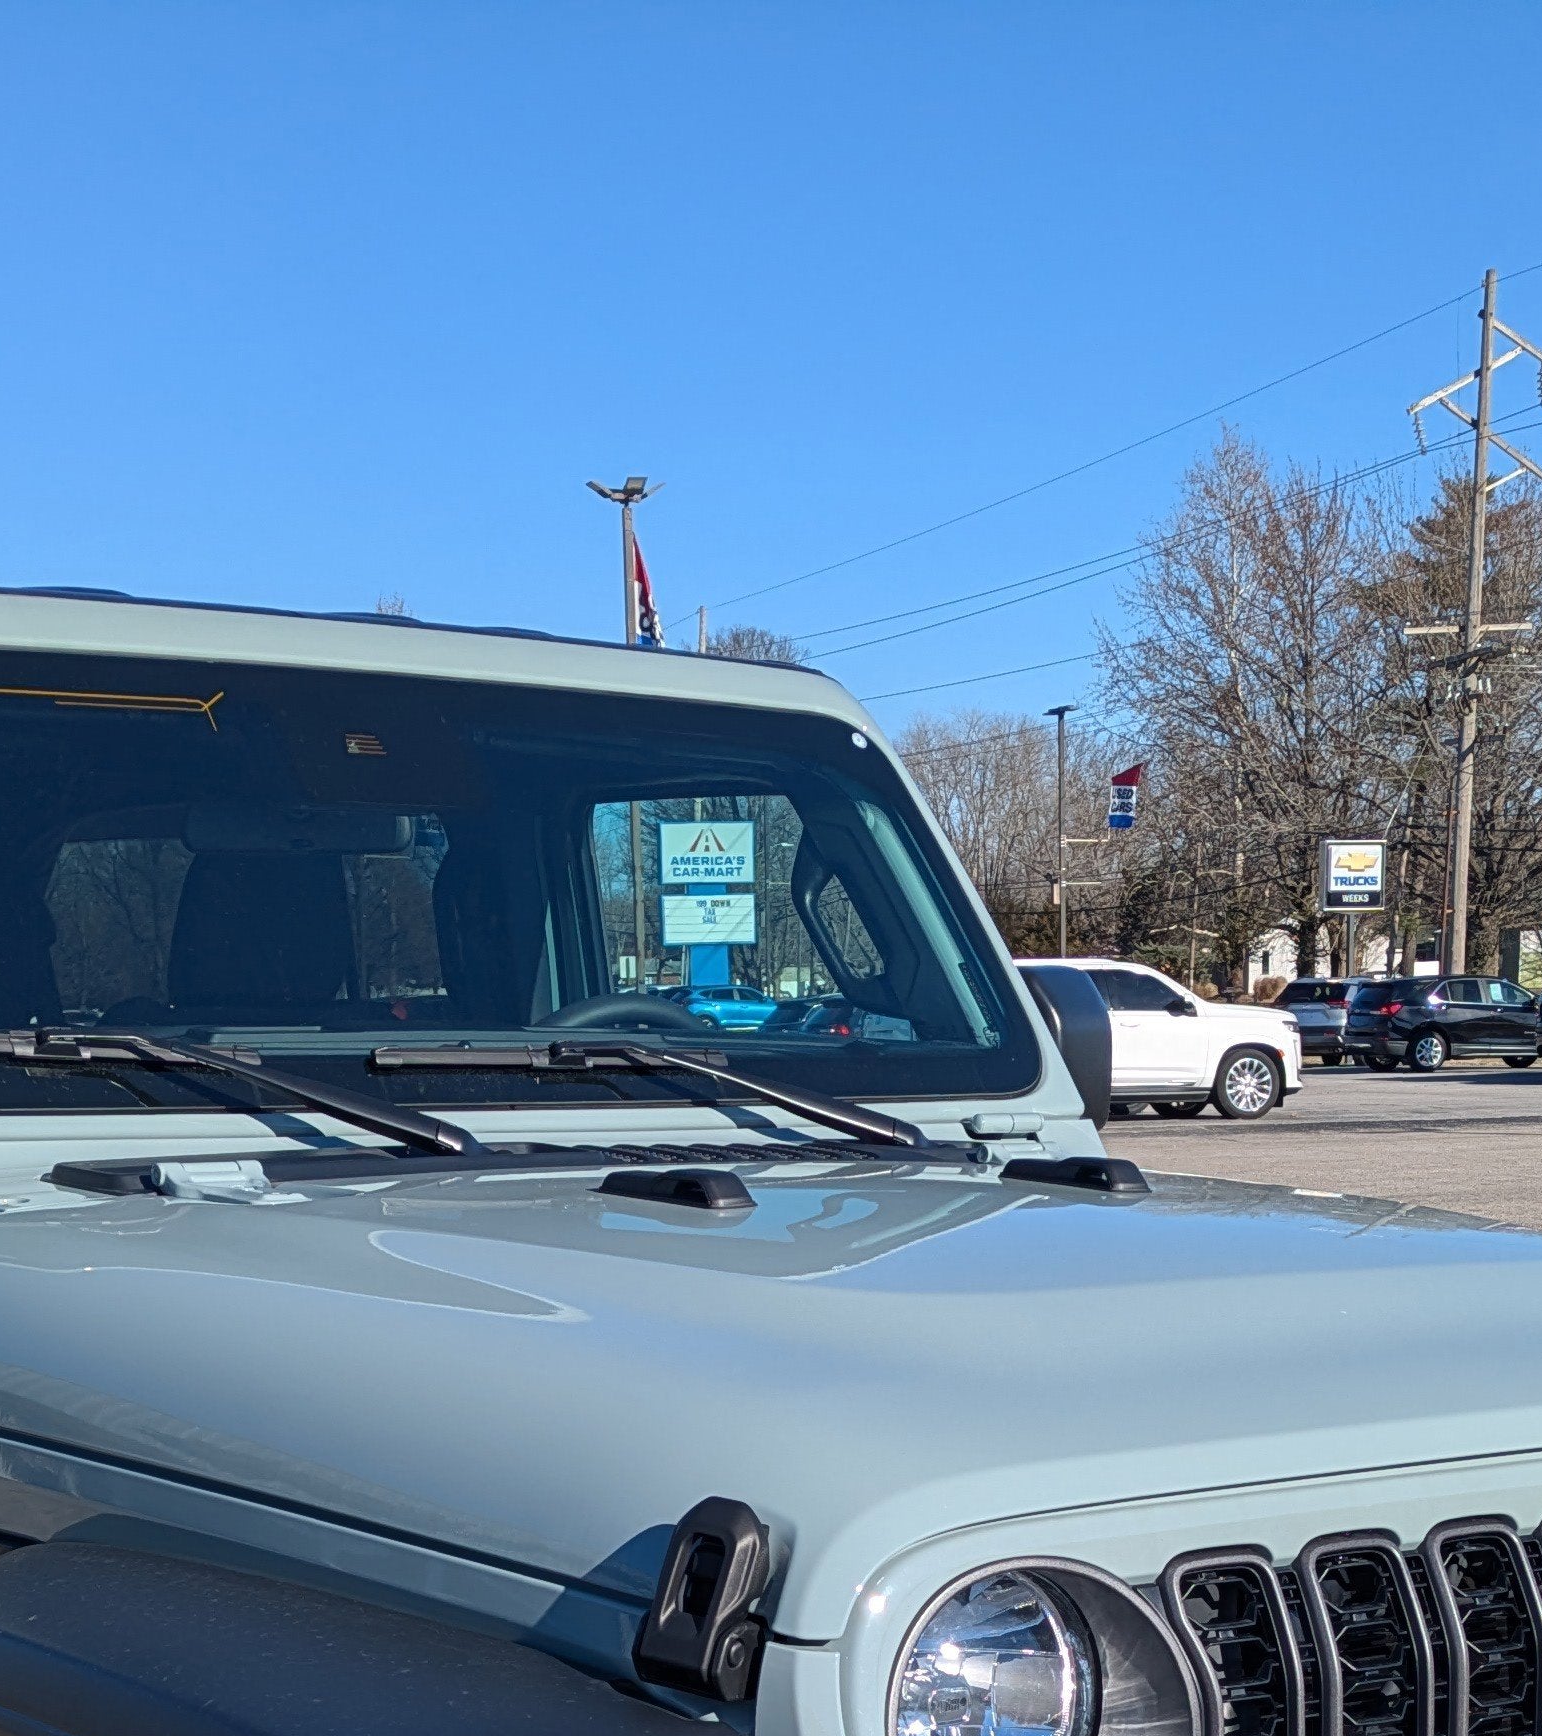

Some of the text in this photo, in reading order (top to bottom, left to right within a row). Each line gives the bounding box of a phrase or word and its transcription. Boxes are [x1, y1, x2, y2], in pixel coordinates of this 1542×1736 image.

[670, 856, 745, 866] AMERICA'S
[672, 866, 743, 877] CAR-MART
[1333, 876, 1378, 886] TRUCKS
[1342, 894, 1369, 903] WEEKS
